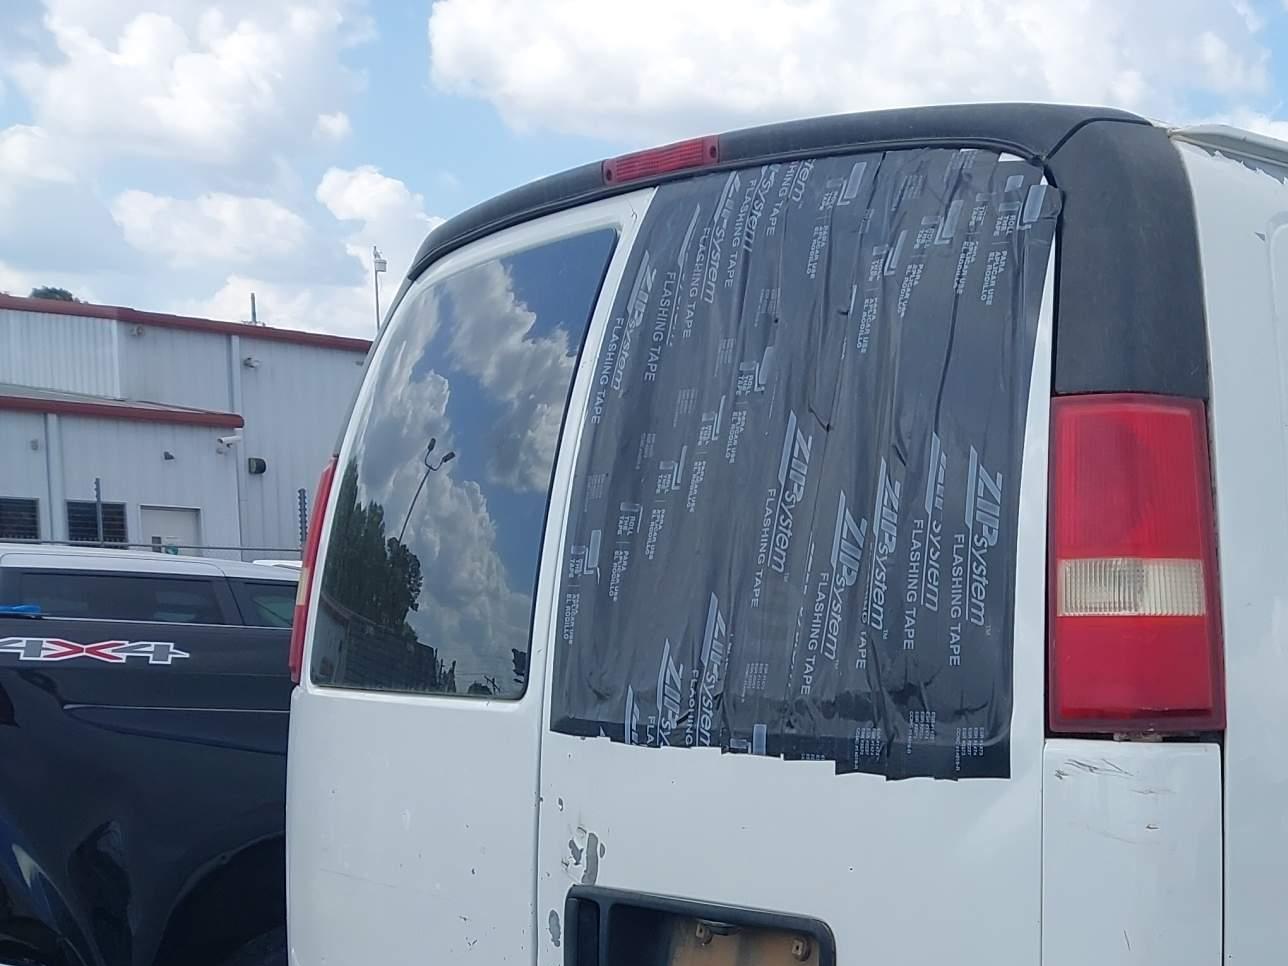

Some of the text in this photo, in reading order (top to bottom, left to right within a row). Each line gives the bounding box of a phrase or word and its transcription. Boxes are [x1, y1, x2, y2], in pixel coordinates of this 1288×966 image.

[725, 180, 756, 288] FLASHING TAPE
[767, 201, 783, 236] TAPE
[644, 271, 677, 381] FLASHING TAPE
[683, 302, 696, 339] TAPE
[591, 317, 625, 424] FLASHING TAPE
[789, 427, 812, 502] ZIP
[976, 464, 1003, 546] ZIP
[751, 488, 776, 609] FLASHING TAPE
[772, 491, 796, 573] system
[839, 508, 868, 586] ZIP
[881, 474, 900, 553] ZIP
[808, 572, 829, 651] FLASHING
[824, 573, 845, 660] system
[871, 544, 888, 630] system
[903, 519, 924, 650] FLASHING TAPE
[950, 534, 965, 666] FLASHING TAPE
[971, 534, 989, 626] system
[801, 655, 817, 695] TAPE
